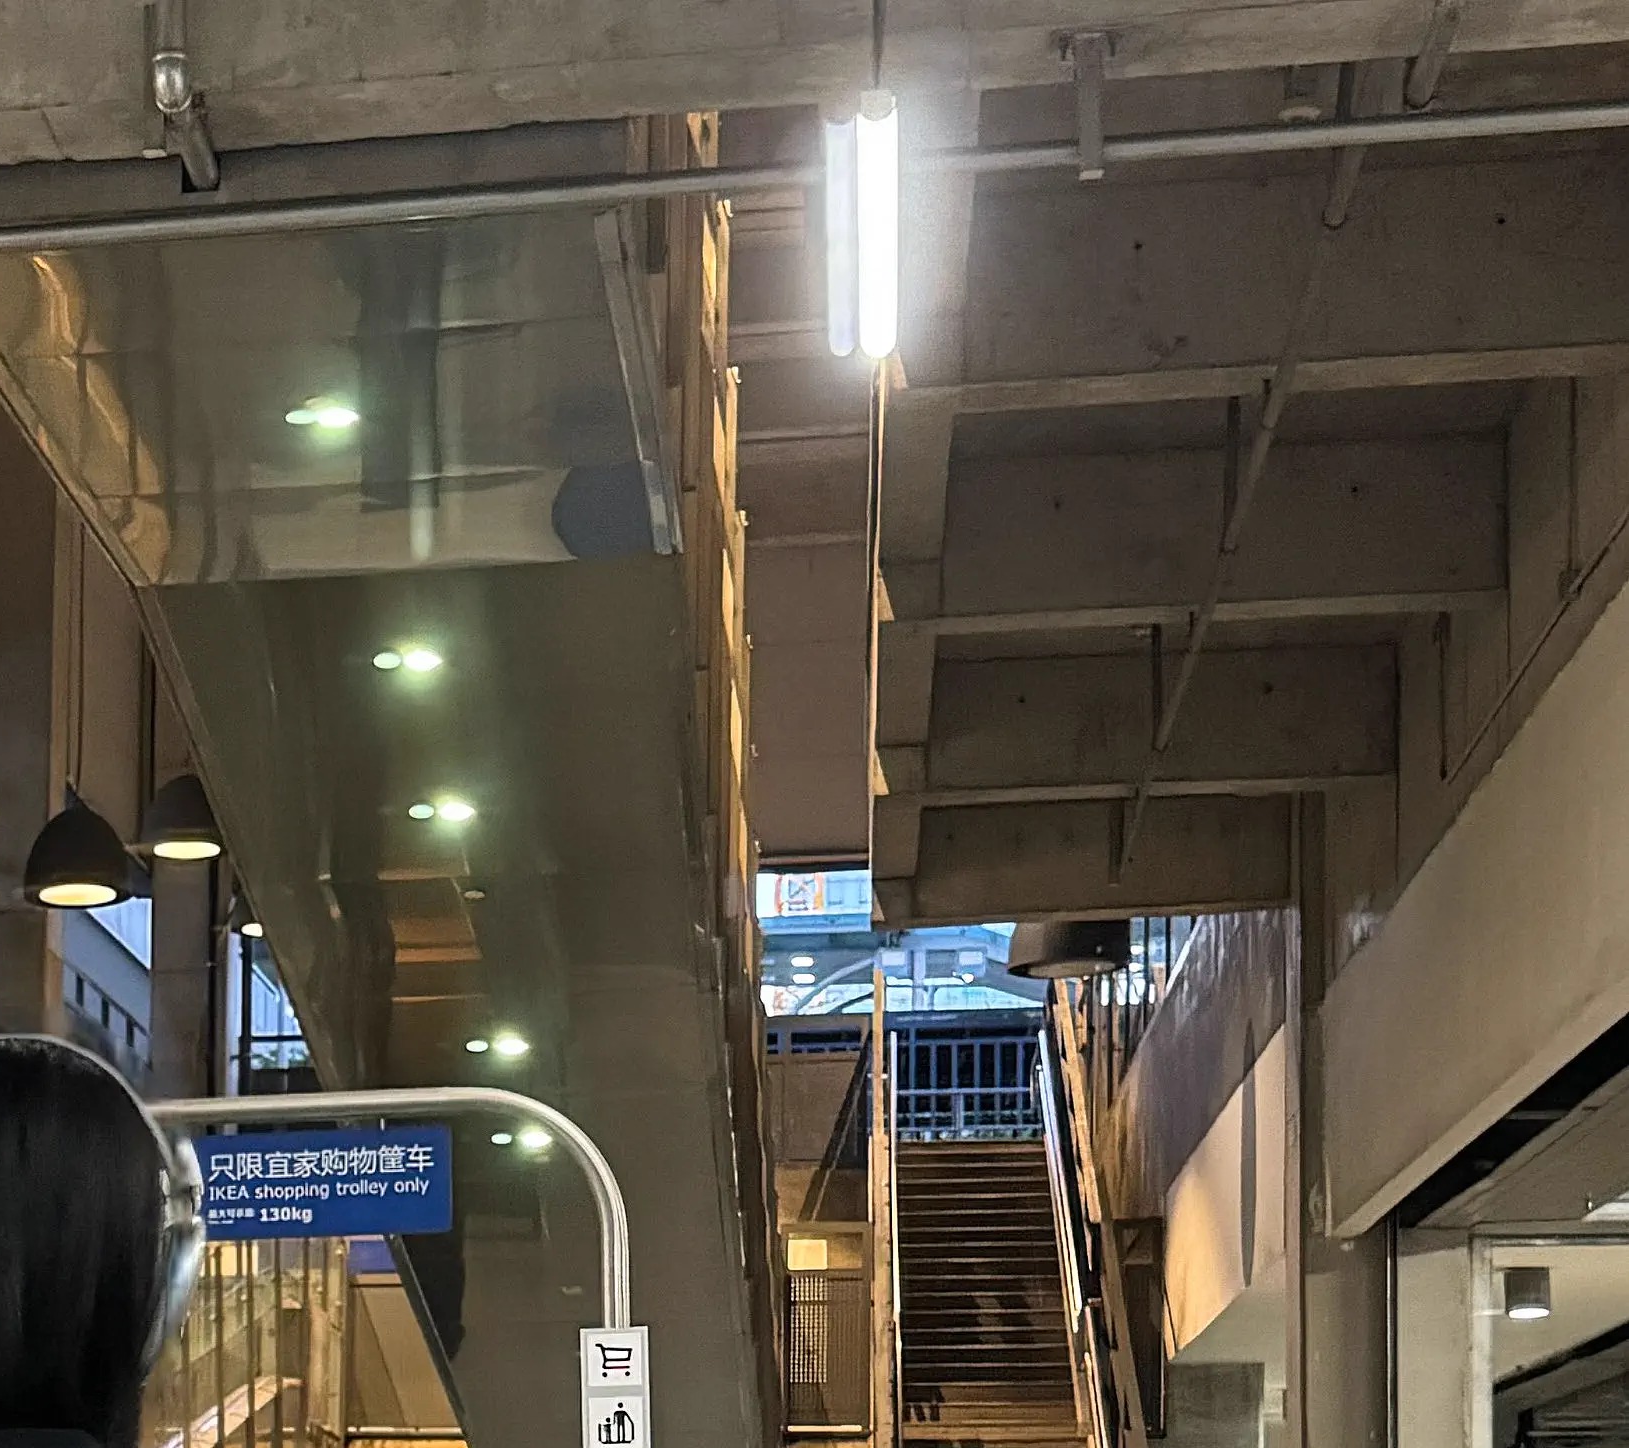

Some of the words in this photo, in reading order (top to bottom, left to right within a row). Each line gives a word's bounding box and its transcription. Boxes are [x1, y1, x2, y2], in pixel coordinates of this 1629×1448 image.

[208, 1144, 435, 1183] 只限宜家购物筐车
[208, 1184, 249, 1201] IKEA
[254, 1181, 330, 1200] shopping
[336, 1177, 388, 1197] trolley
[394, 1177, 430, 1195] only
[260, 1206, 313, 1224] 130kg
